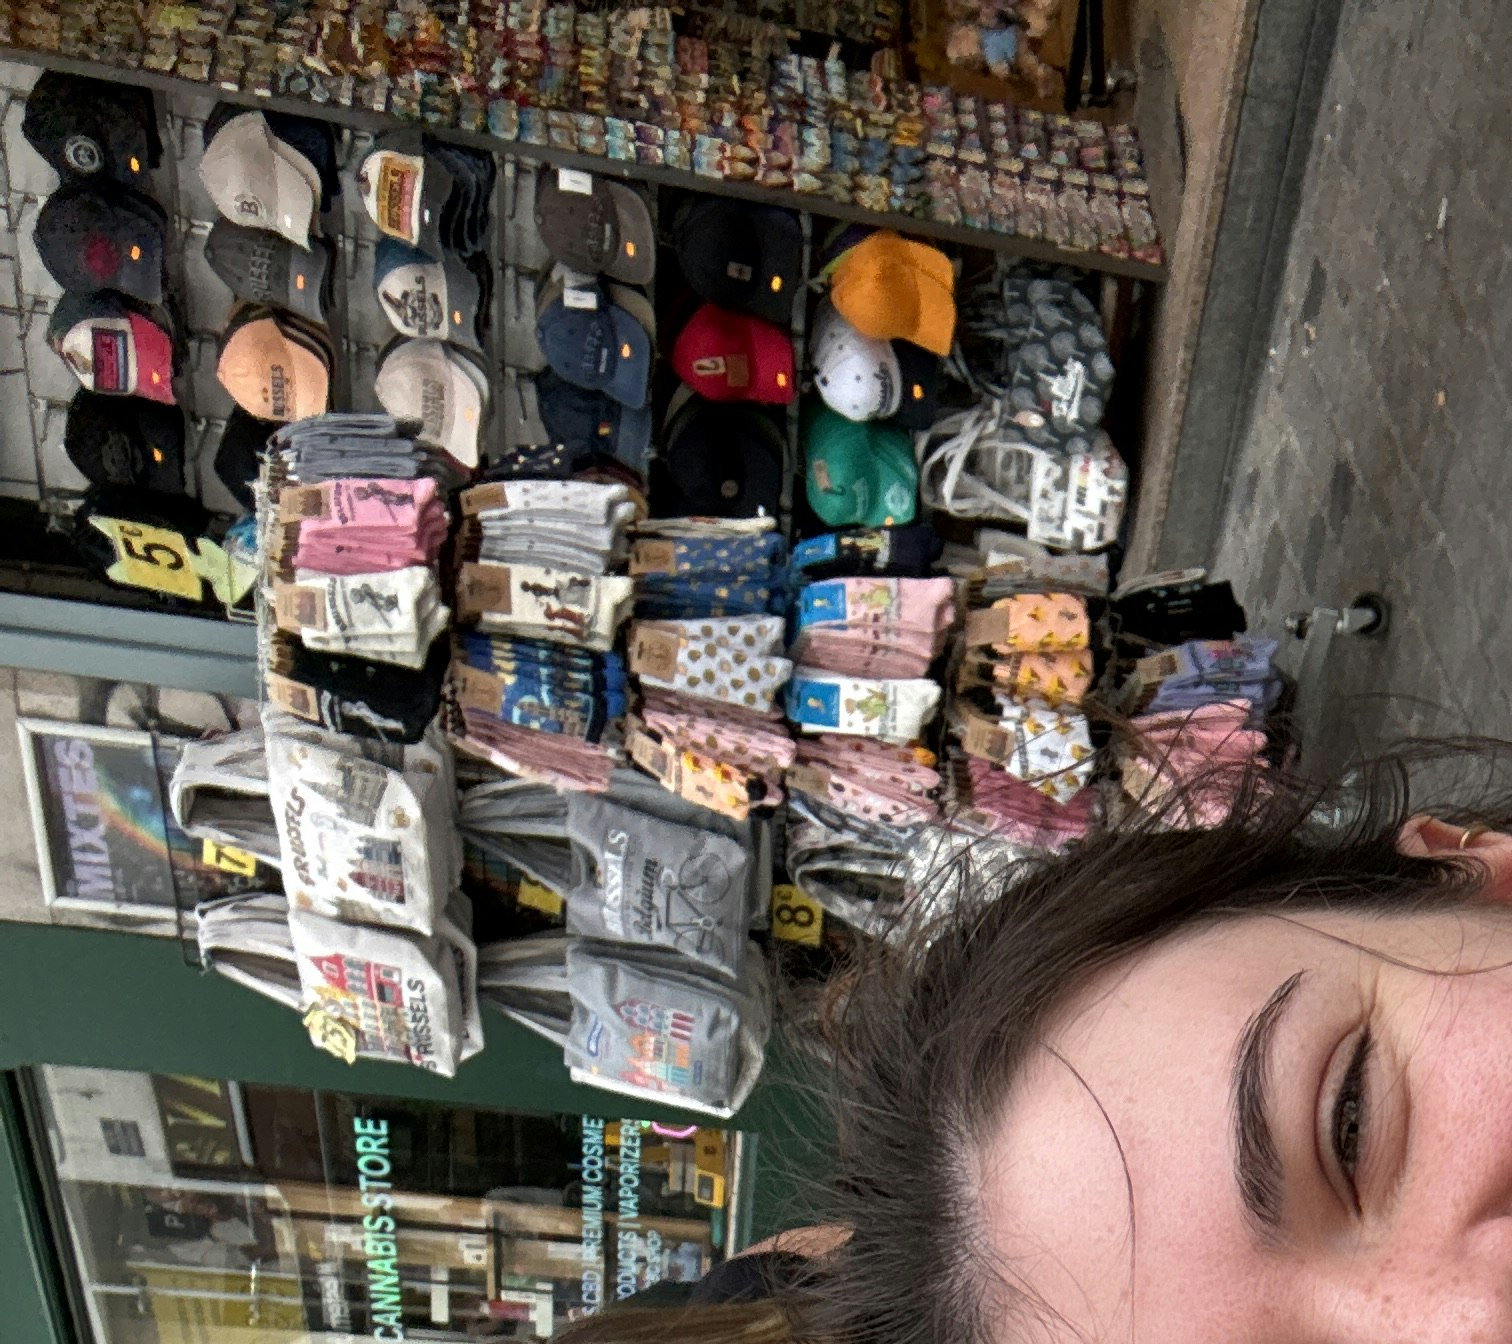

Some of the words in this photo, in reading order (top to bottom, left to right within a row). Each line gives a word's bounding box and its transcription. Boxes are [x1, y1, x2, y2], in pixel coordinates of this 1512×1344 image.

[53, 739, 115, 899] MIXTES
[353, 1116, 395, 1210] STORE
[581, 1184, 602, 1262] PREMIUM
[616, 1231, 638, 1300] ODUCTS
[361, 1215, 404, 1342] CANNABIS
[581, 1270, 601, 1304] CBD
